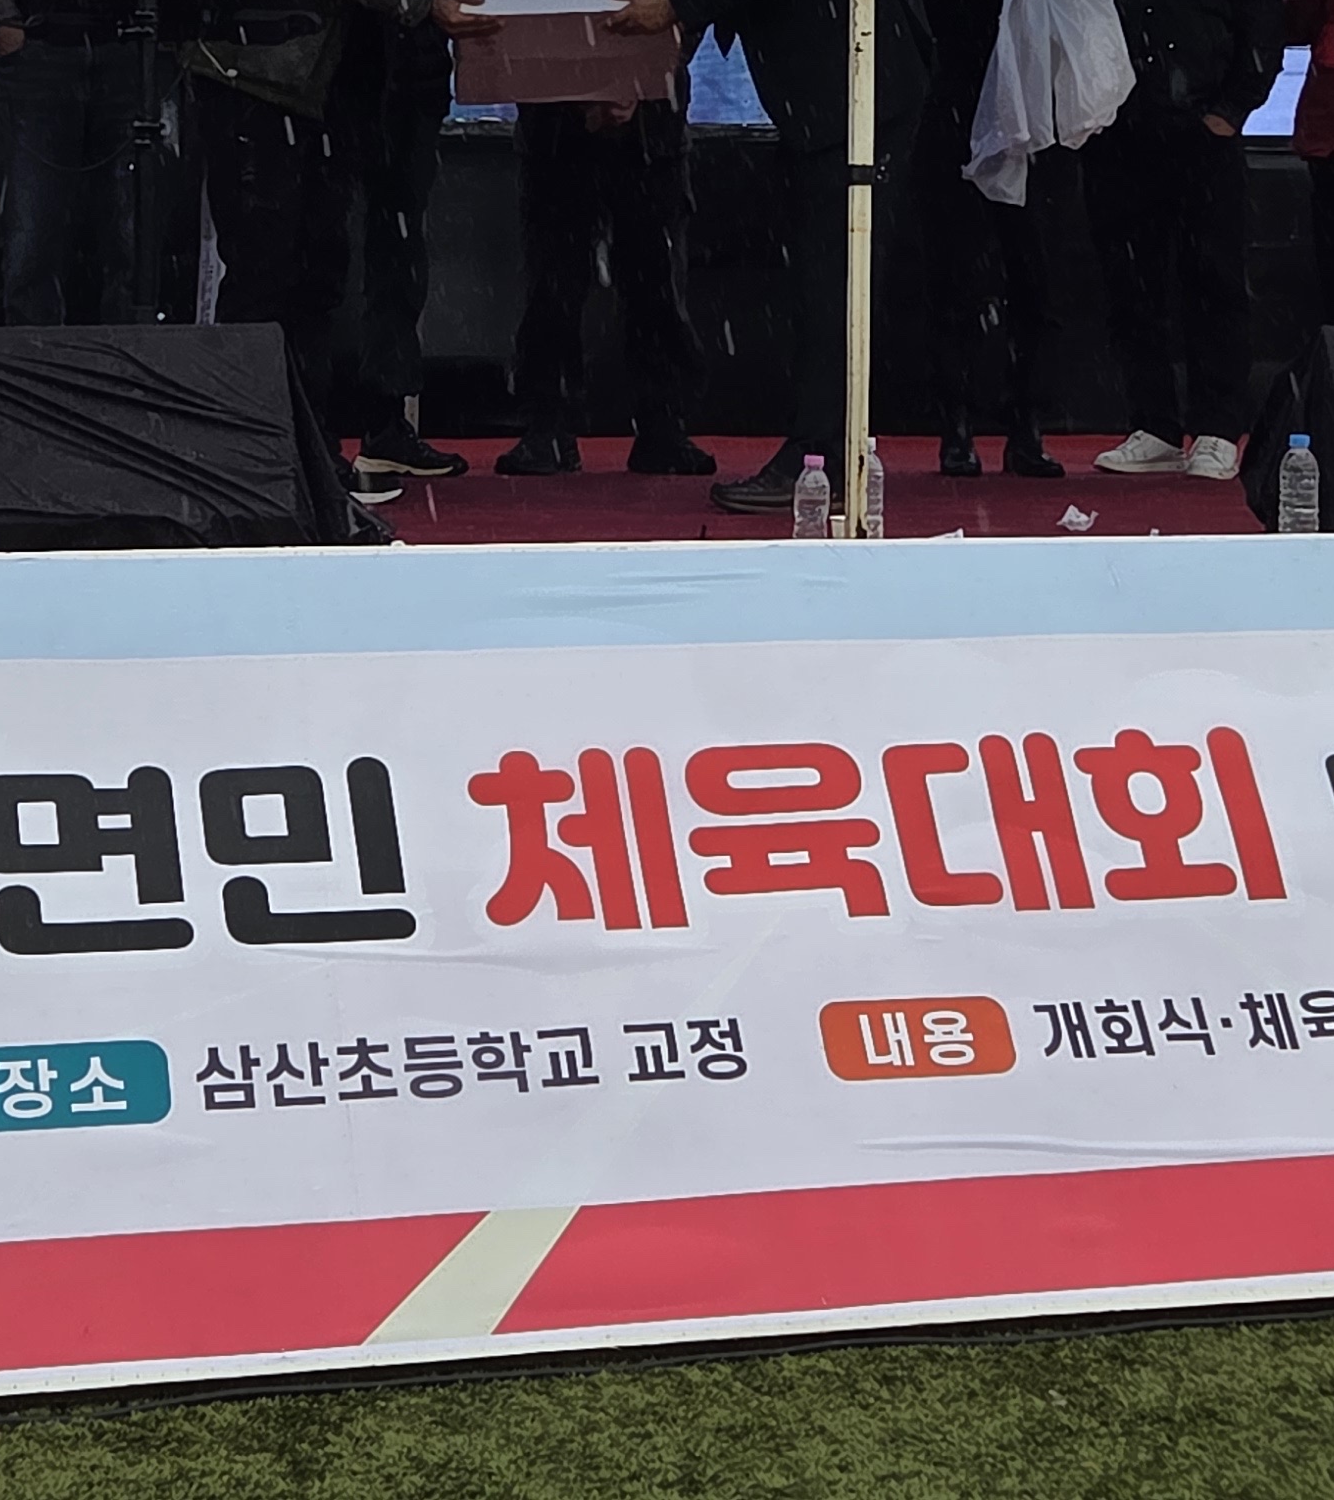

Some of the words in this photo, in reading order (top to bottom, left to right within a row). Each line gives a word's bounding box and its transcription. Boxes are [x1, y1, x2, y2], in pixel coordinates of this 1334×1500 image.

[466, 725, 1289, 930] 체육대회
[195, 1026, 601, 1112] 삼산초등학교
[626, 1016, 749, 1083] 교정
[860, 1012, 976, 1067] 내용
